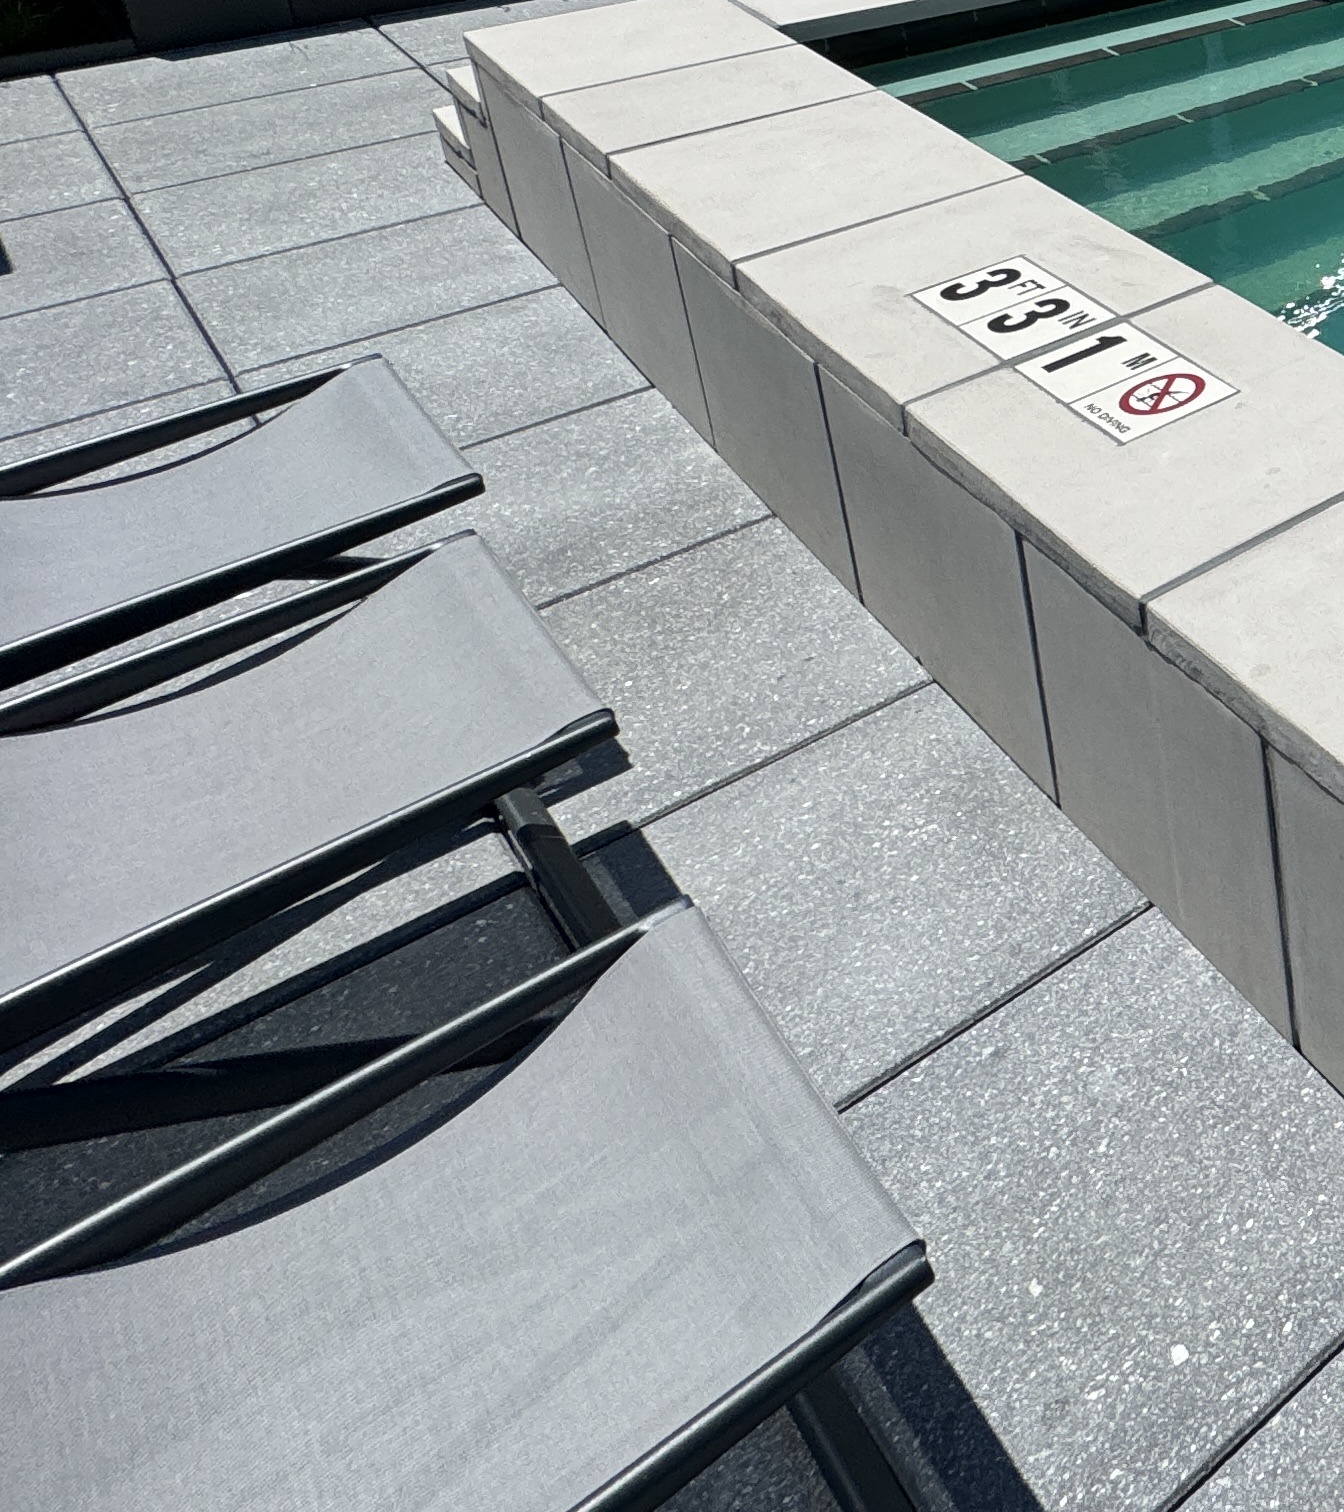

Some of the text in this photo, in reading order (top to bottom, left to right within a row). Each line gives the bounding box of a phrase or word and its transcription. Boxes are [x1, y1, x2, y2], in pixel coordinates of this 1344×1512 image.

[940, 268, 1157, 373] 3 FT 3 IN 1 M
[1083, 403, 1103, 415] NO
